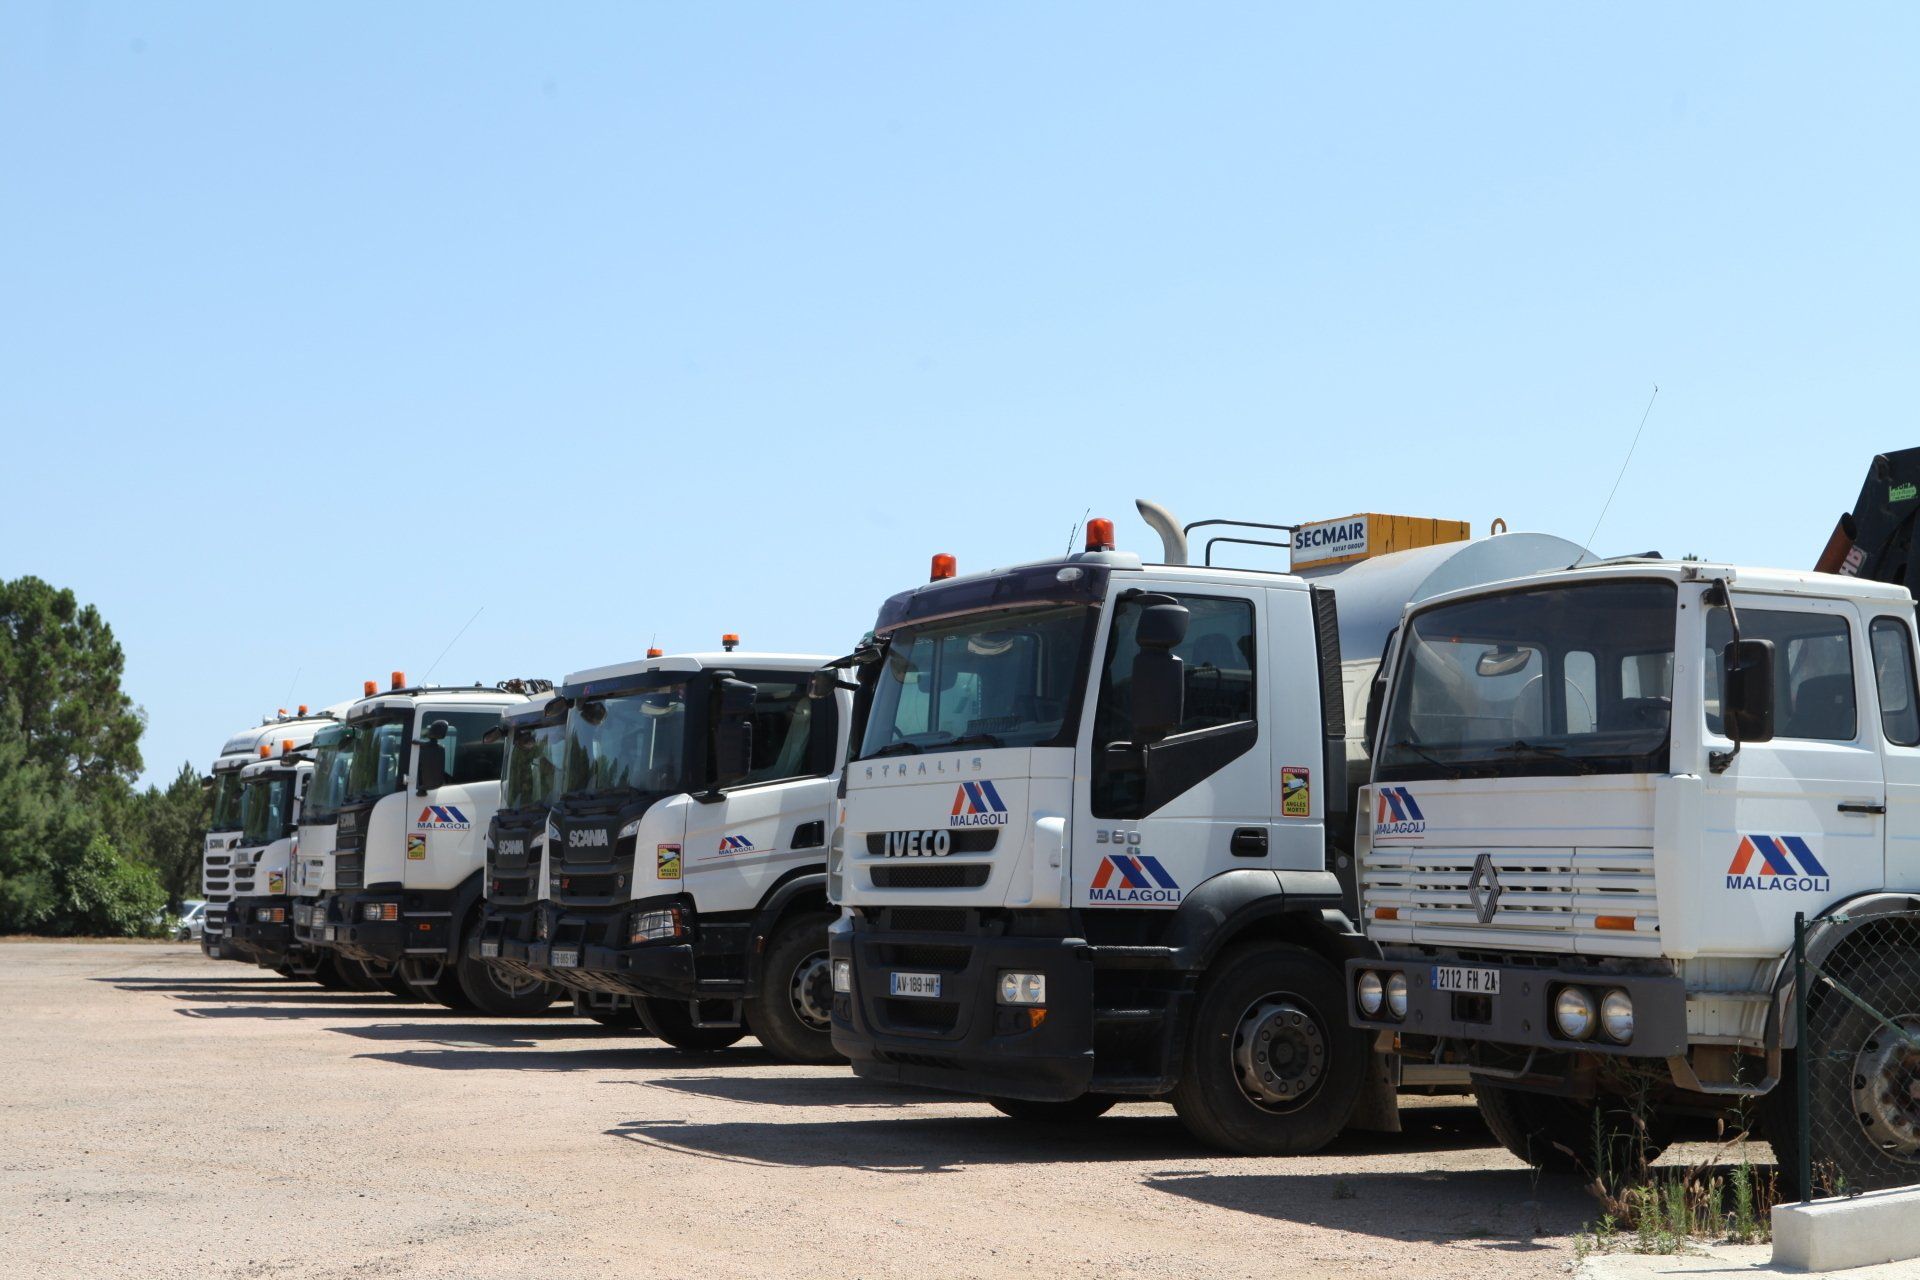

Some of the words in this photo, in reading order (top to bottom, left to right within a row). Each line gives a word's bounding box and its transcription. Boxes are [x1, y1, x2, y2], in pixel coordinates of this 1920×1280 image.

[1295, 522, 1364, 549] SECMAIR
[1347, 541, 1365, 551] GROUP
[865, 757, 982, 780] STRALIS
[417, 822, 471, 830] MALAGOLI
[950, 813, 1008, 827] MALAGOLI
[1375, 821, 1426, 835] MALAGOLI
[568, 829, 609, 847] SCANIA
[884, 829, 951, 858] IVECO
[1096, 829, 1142, 845] 360
[498, 840, 525, 855] SCANIA
[718, 845, 755, 856] MALAGOLI
[1726, 875, 1830, 892] MALAGOLI
[1089, 888, 1181, 902] MALAGOLI
[1439, 968, 1462, 989] 2112
[1467, 970, 1479, 990] FH
[1484, 971, 1496, 991] 2A
